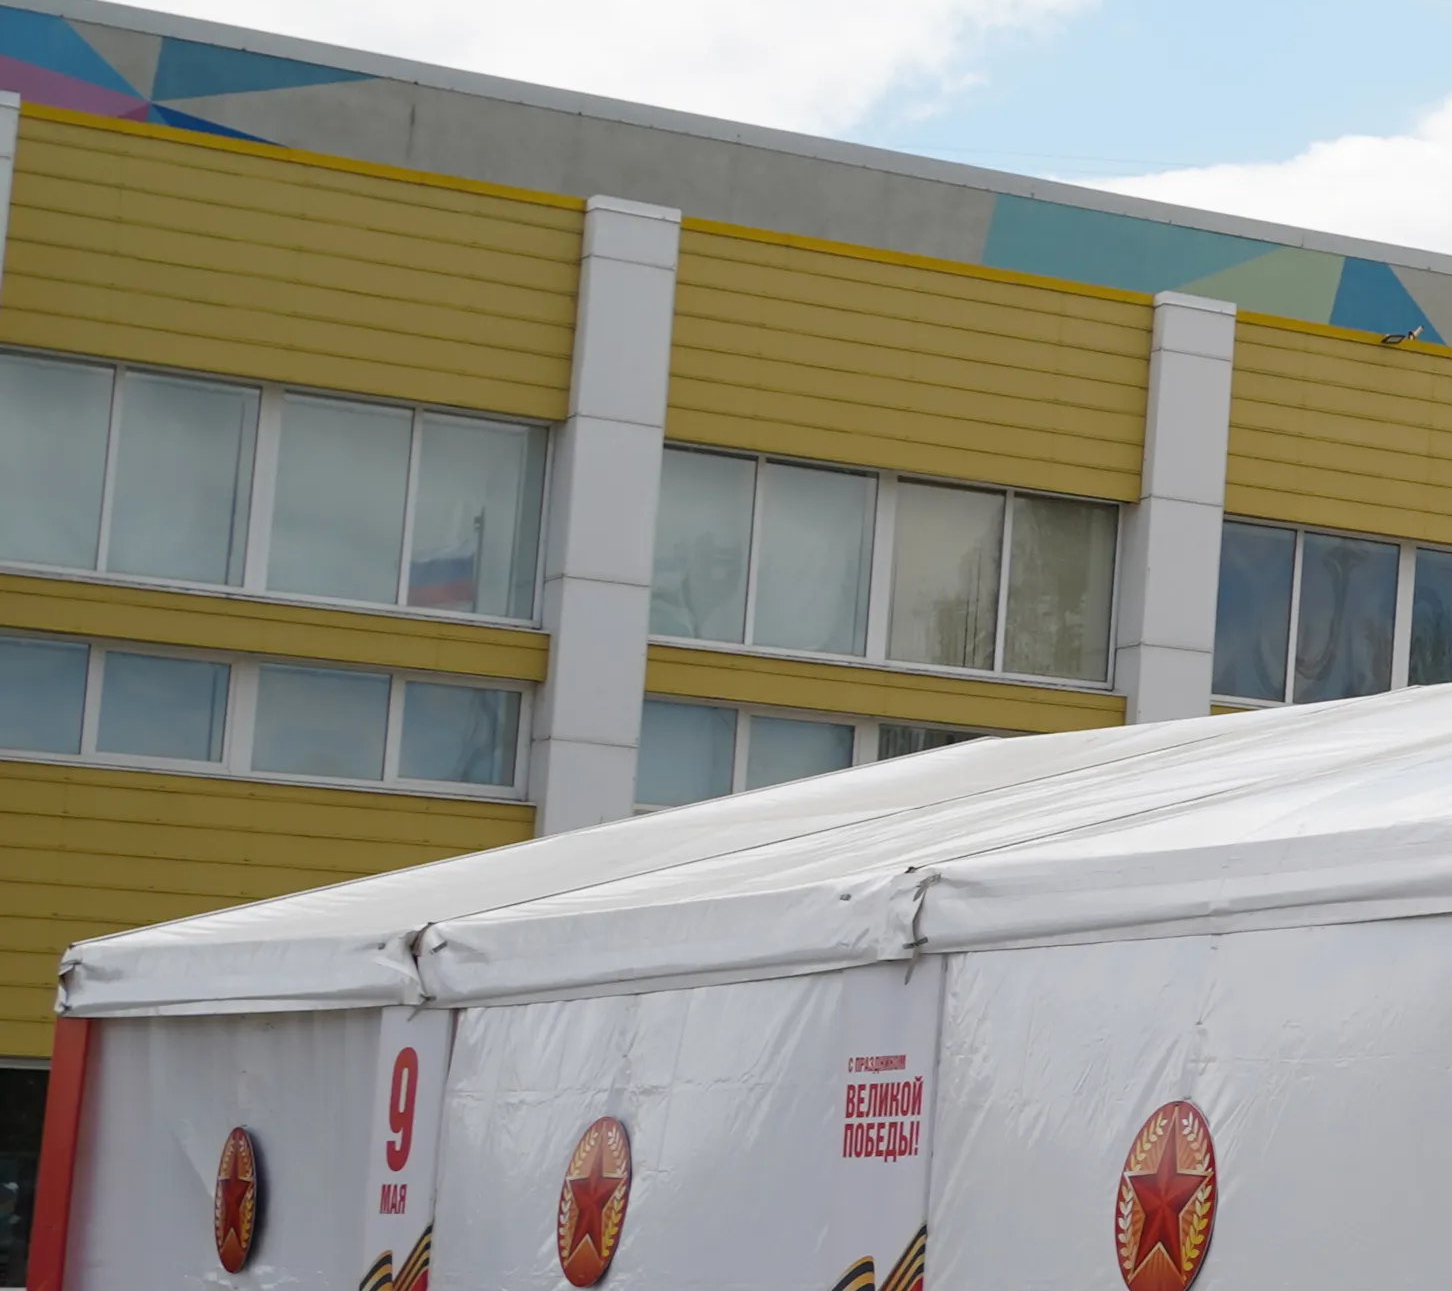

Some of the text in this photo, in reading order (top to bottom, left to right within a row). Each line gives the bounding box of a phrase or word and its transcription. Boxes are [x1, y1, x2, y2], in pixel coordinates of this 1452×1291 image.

[386, 1047, 418, 1172] 9
[845, 1076, 923, 1118] ВЕЛИКОЙ
[842, 1121, 920, 1163] ПОБЕДЫ!
[379, 1184, 407, 1214] МАЯ
